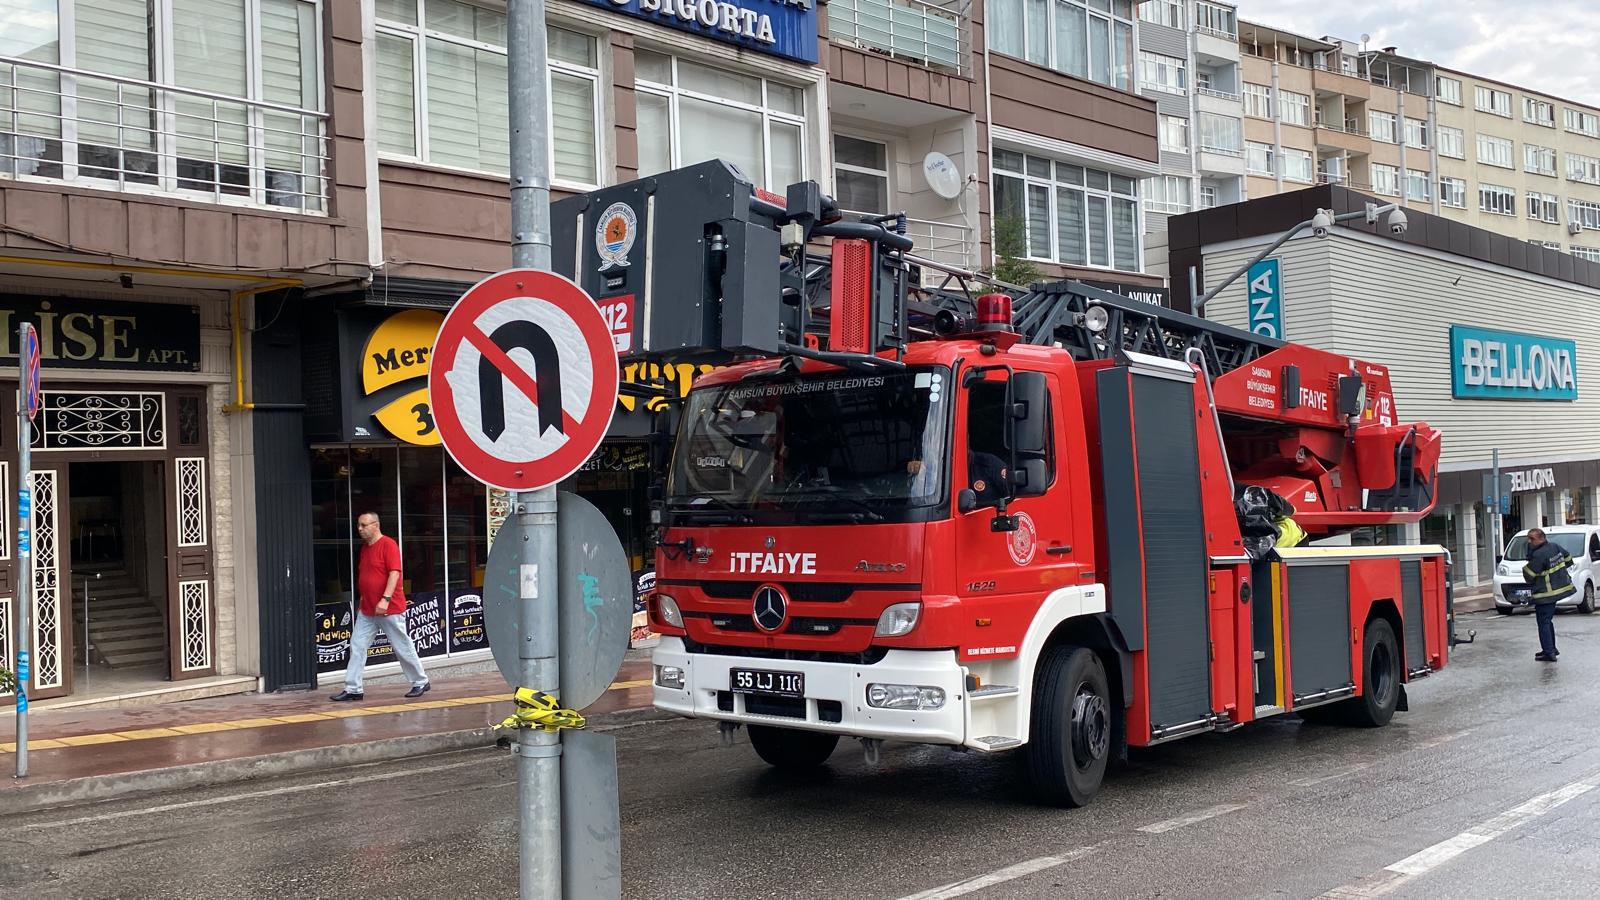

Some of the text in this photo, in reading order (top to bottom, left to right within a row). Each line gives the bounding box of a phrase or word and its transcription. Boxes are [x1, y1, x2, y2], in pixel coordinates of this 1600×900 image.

[146, 350, 188, 364] APT.
[372, 346, 434, 375] Mer
[1462, 339, 1575, 390] BELLONA
[1251, 366, 1272, 379] SAMSUN
[728, 388, 765, 400] SAMSUN
[1380, 396, 1390, 415] 112
[409, 610, 440, 629] AYRAN
[414, 631, 443, 652] ALAN
[317, 650, 346, 664] EZZET
[737, 671, 753, 687] 55
[757, 674, 773, 690] LJ
